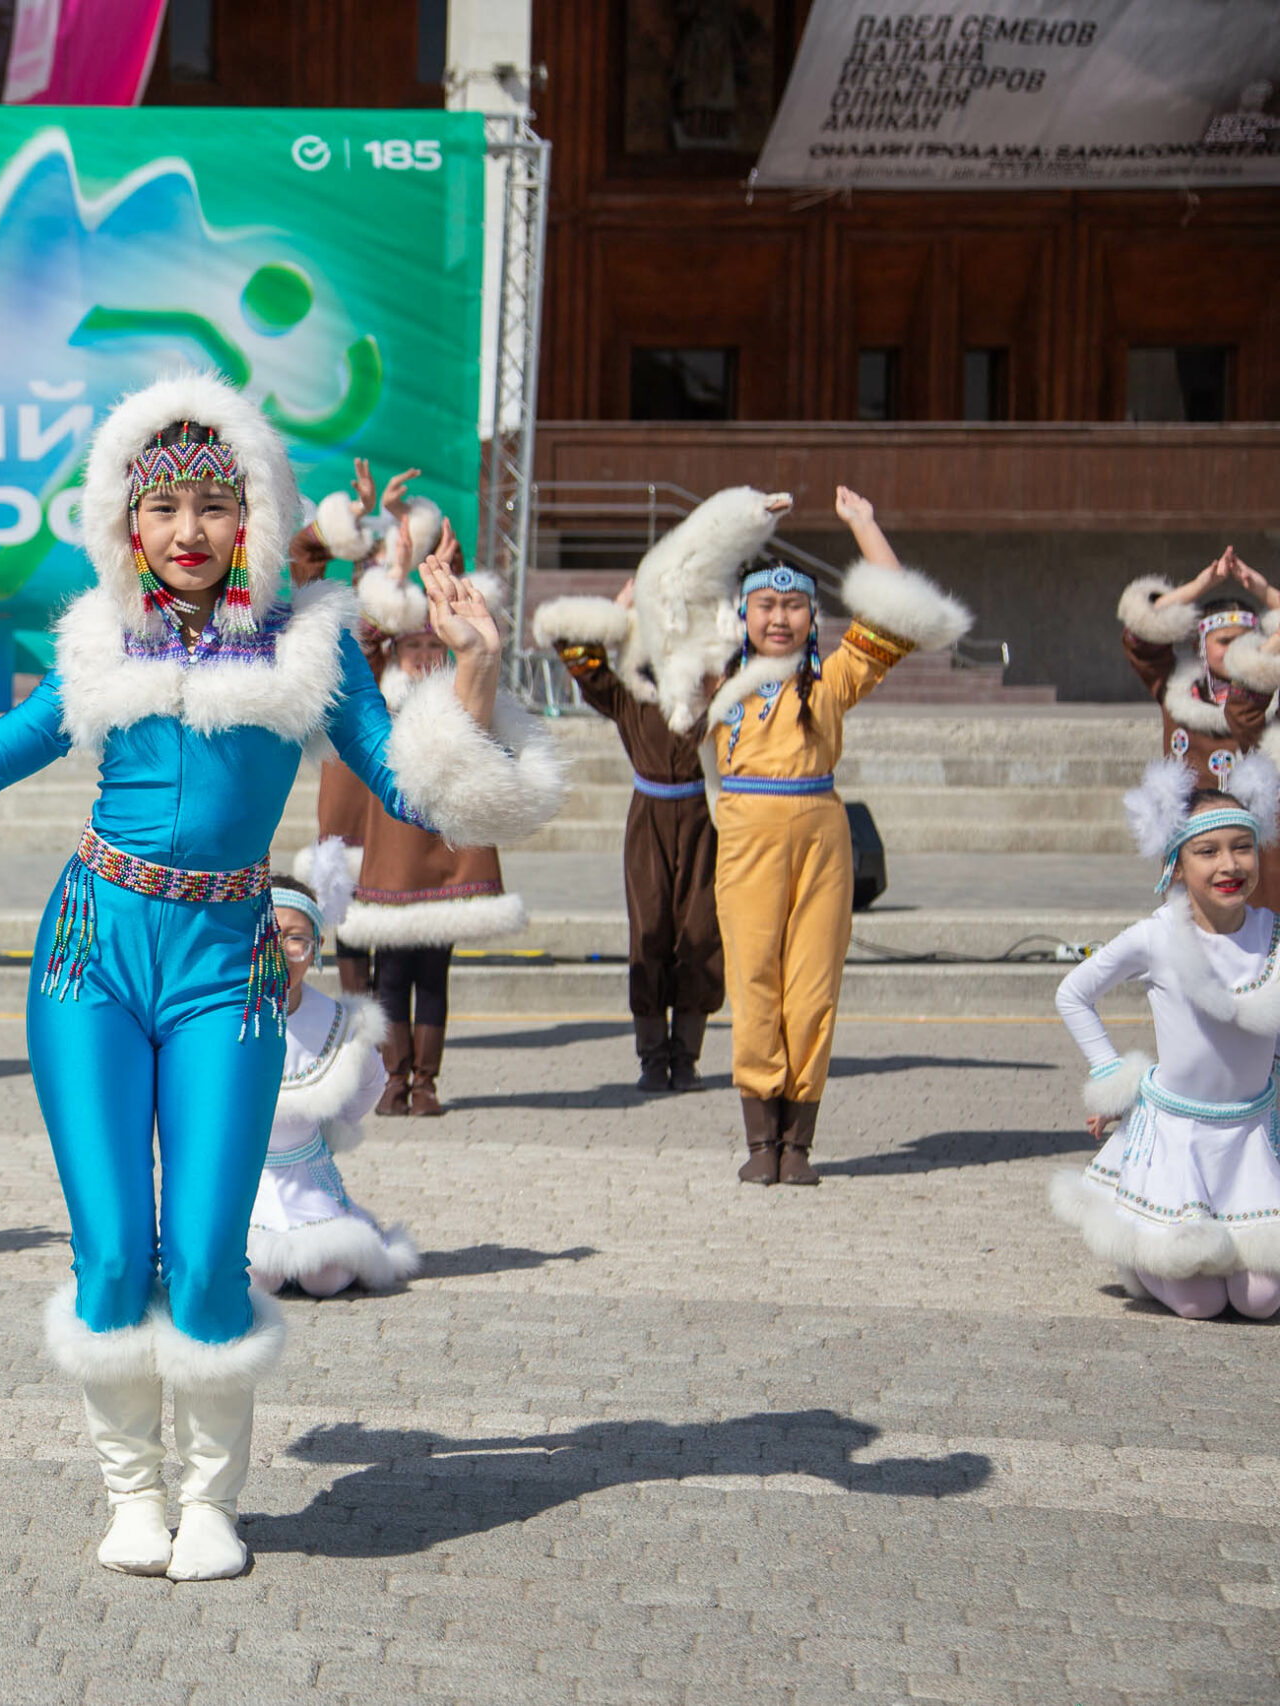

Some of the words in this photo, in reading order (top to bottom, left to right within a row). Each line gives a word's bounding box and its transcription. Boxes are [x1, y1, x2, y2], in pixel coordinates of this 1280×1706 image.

[854, 15, 951, 43] ПАВЕЛ
[958, 16, 1097, 48] СЕМЕНОВ
[838, 61, 928, 89] ИГОРЬ
[935, 64, 1047, 93] ЕГОРОВ
[822, 112, 941, 133] АМИКАН
[364, 140, 443, 171] 185
